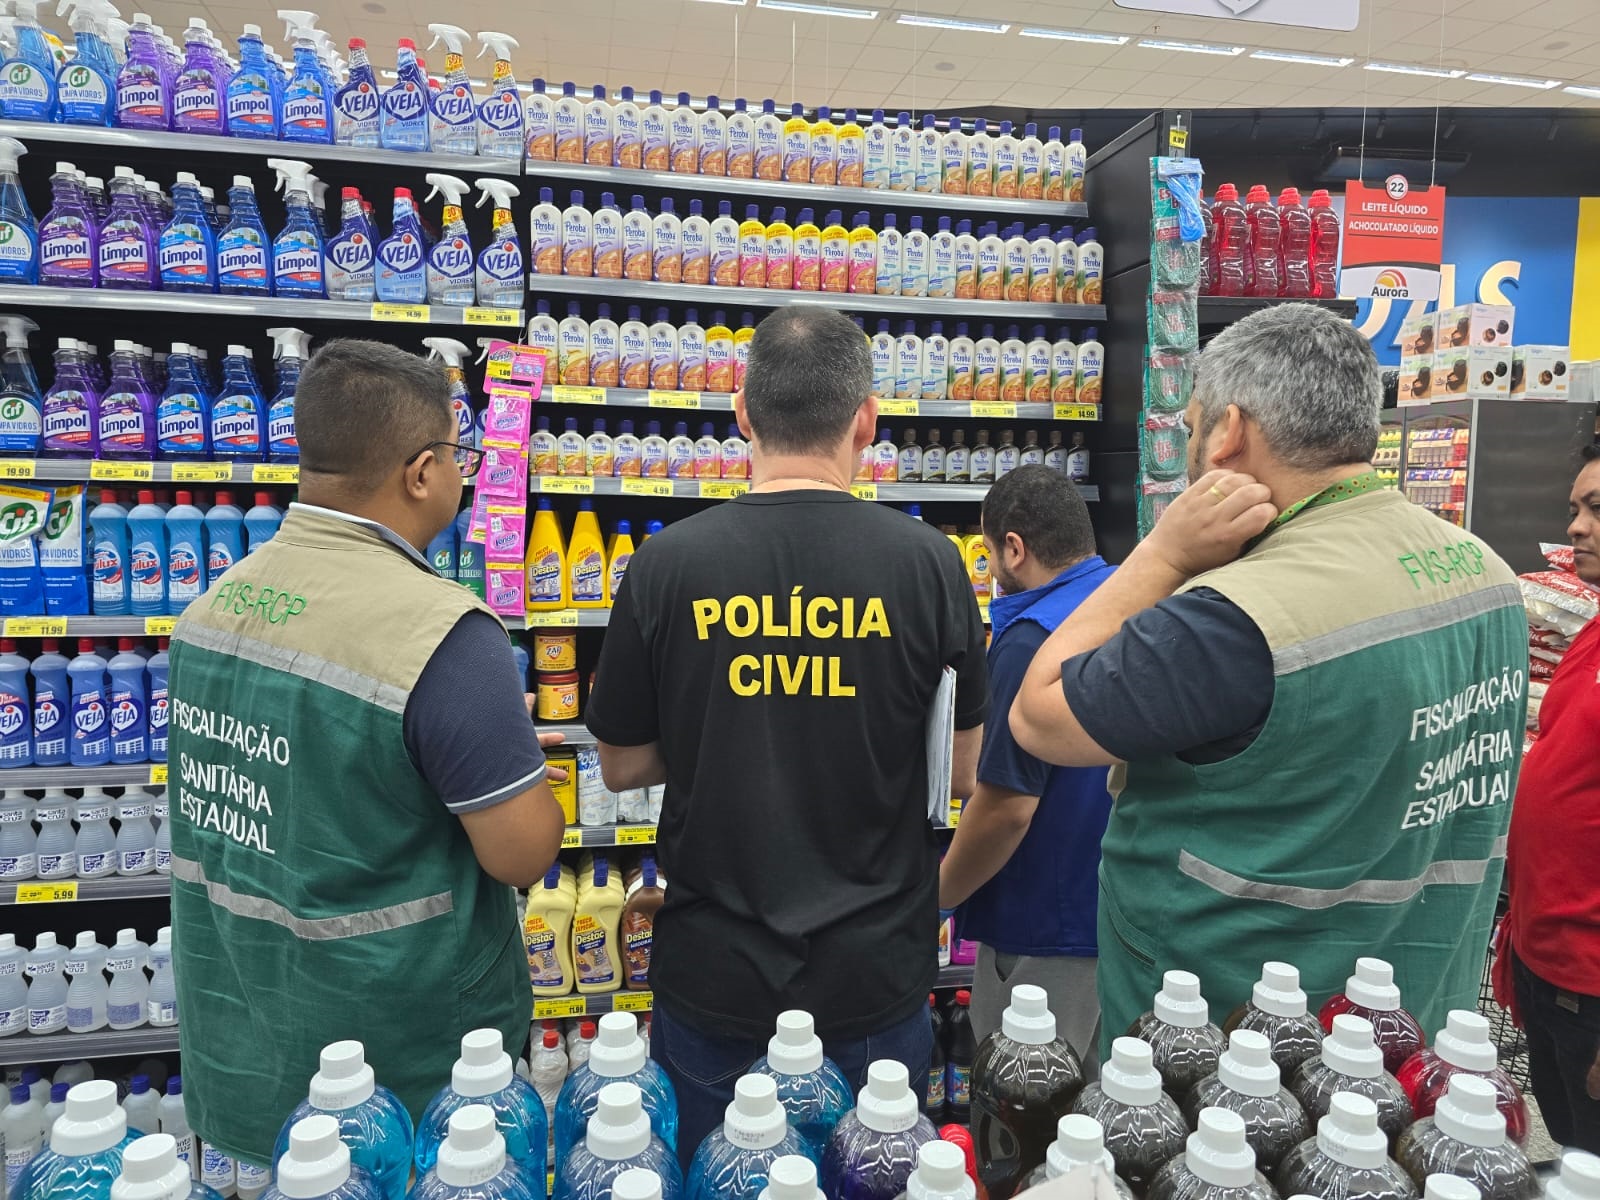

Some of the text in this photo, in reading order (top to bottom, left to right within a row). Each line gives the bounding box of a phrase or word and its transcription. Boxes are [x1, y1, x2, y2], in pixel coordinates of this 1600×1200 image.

[19, 88, 43, 98] VIDROS
[81, 90, 102, 100] VIDROS
[119, 89, 159, 106] Limpol
[177, 92, 215, 109] Limpol
[230, 98, 269, 114] Limpol
[345, 94, 377, 115] VEJA
[390, 94, 422, 114] VEJA
[438, 95, 473, 116] VEJA
[285, 102, 323, 118] Limpol
[484, 104, 519, 122] VEJA
[527, 108, 549, 122] Peroba
[555, 111, 576, 124] Peroba
[586, 112, 607, 126] Peroba
[617, 115, 638, 129] Peroba
[643, 119, 664, 133] Peroba
[673, 121, 693, 134] Peroba
[702, 124, 721, 138] Peroba
[729, 126, 749, 139] Peroba
[758, 128, 778, 141] Peroba
[1390, 182, 1404, 193] 22
[1361, 201, 1428, 216] LEITE LÍQUIDO
[535, 219, 555, 233] Peroba
[565, 220, 586, 234] Peroba
[595, 223, 616, 237] Peroba
[625, 226, 646, 240] Peroba
[1349, 220, 1438, 235] ACHOCOLATADO LÍQUIDO
[655, 228, 676, 242] Peroba
[683, 230, 703, 245] Peroba
[716, 232, 736, 246] Peroba
[1, 247, 26, 256] VIDROS
[43, 242, 88, 260] Limpol
[101, 246, 143, 263] Limpol
[743, 242, 763, 256] Peroba
[767, 244, 787, 258] Peroba
[162, 249, 203, 266] Limpol
[220, 252, 262, 270] Limpol
[336, 248, 371, 266] VEJA
[385, 248, 419, 265] VEJA
[436, 252, 471, 269] VEJA
[485, 255, 520, 272] VEJA
[277, 257, 317, 272] Limpol
[350, 271, 375, 281] VIDREX
[399, 272, 423, 281] VIDREX
[449, 277, 474, 286] VIDREX
[499, 279, 523, 288] VIDREX
[1371, 287, 1409, 298] Aurora
[534, 330, 556, 343] Peroba
[563, 331, 585, 344] Peroba
[592, 333, 614, 347] Peroba
[624, 335, 645, 348] Peroba
[650, 335, 672, 349] Peroba
[682, 337, 703, 350] Peroba
[709, 345, 728, 359] Peroba
[2, 402, 24, 420] Cif
[1077, 410, 1095, 419] 14.99
[14, 421, 37, 432] VIDROS
[46, 415, 87, 433] Limpol
[101, 418, 140, 435] Limpol
[159, 420, 199, 437] Limpol
[215, 420, 255, 437] Limpol
[271, 421, 296, 439] Limp
[6, 467, 31, 477] 19.99
[214, 470, 230, 480] 7.99
[653, 486, 669, 495] 4.99
[0, 507, 38, 538] Cif
[46, 501, 73, 537] Cif
[6, 547, 31, 559] VIDROS
[50, 548, 79, 559] VIDROS
[575, 564, 601, 577] Destac
[1398, 540, 1484, 590] FVS-RCP
[209, 580, 307, 626] FVS-RCP
[692, 585, 892, 640] POLÍCIA
[40, 625, 63, 636] 11.99
[728, 654, 856, 697] CIVIL
[1409, 665, 1523, 741] FISCALIZAÇÃO
[77, 709, 105, 727] VEJA
[111, 708, 135, 725] VEJA
[173, 698, 290, 767] FISCALIZAÇÃO
[1415, 728, 1513, 792] SANITÁRIA
[180, 752, 273, 817] SANITÁRIA
[47, 807, 67, 816] santa
[90, 806, 109, 815] santa
[90, 812, 109, 820] cruz
[132, 804, 151, 814] santa
[132, 809, 151, 817] cruz
[47, 813, 67, 821] cruz
[180, 787, 275, 855] ESTADUAL
[53, 890, 73, 900] 5.99
[526, 932, 554, 946] Destac
[576, 931, 605, 946] Destac
[36, 961, 55, 970] santa
[114, 958, 133, 967] santa
[114, 963, 133, 971] cruz
[36, 966, 56, 975] cruz
